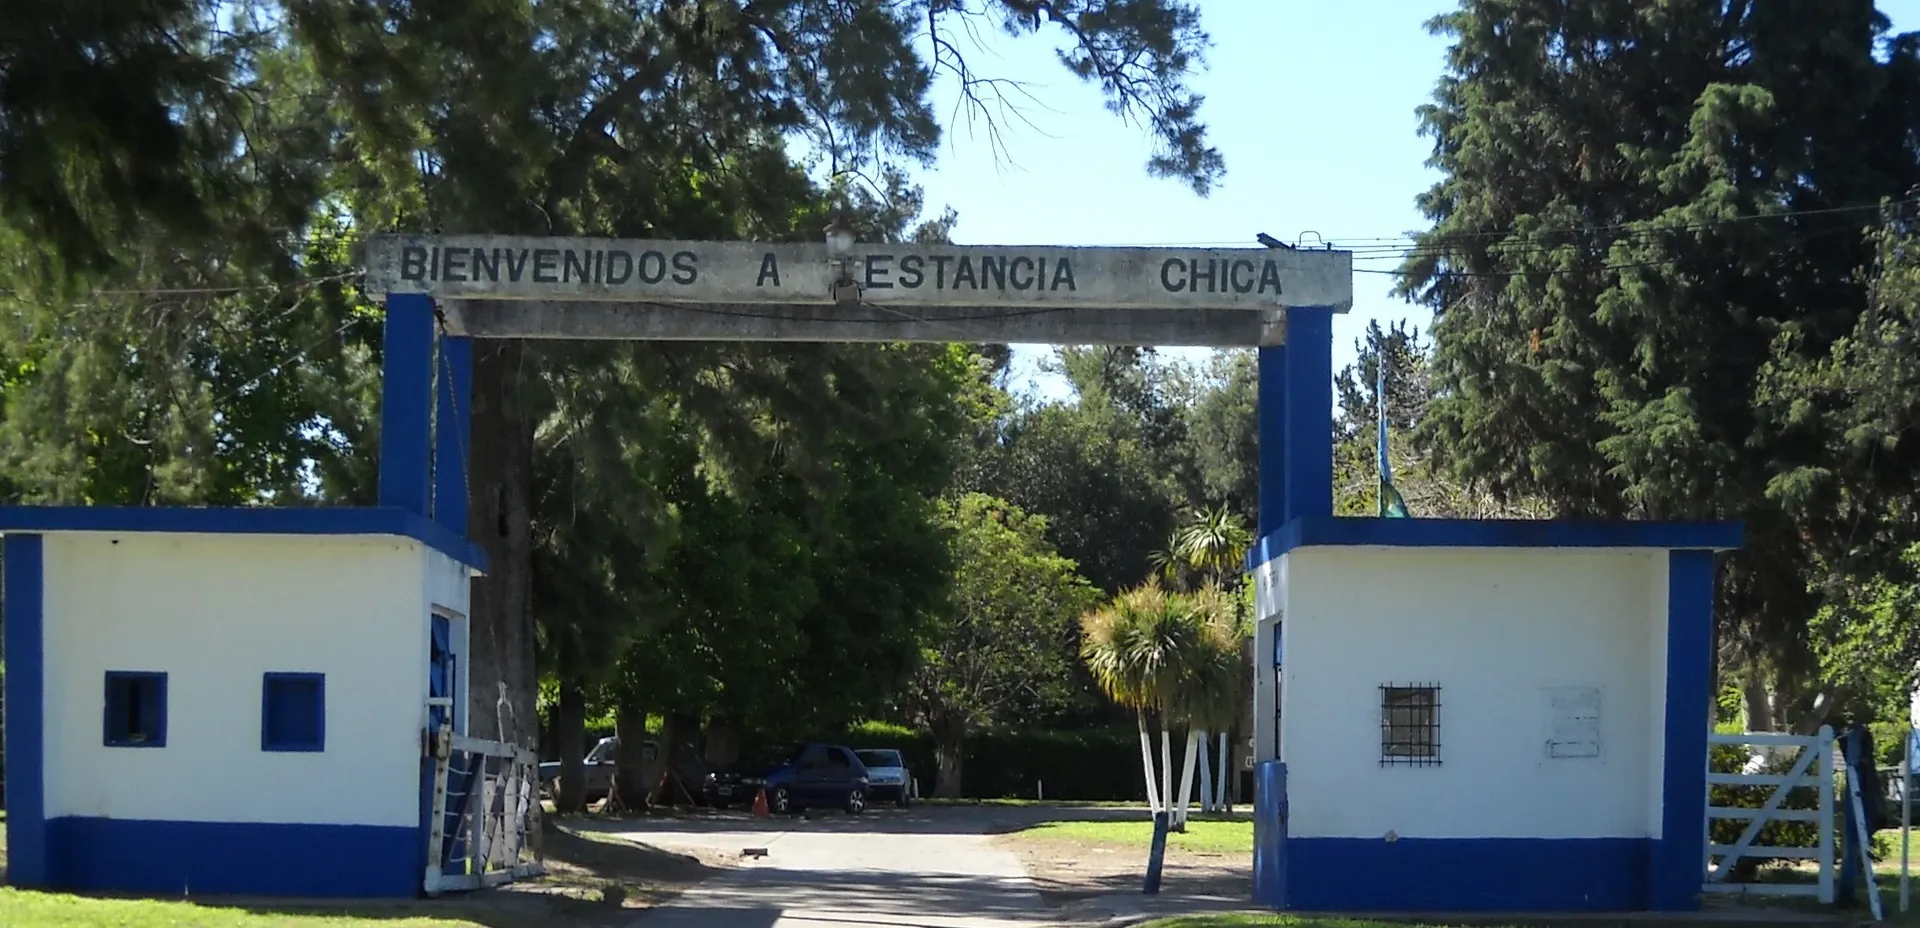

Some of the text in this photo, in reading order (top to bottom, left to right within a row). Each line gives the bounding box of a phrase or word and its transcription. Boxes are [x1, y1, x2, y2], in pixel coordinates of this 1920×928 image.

[401, 246, 1282, 295] BIENVENIDOS A ESTANCIA CHICA
